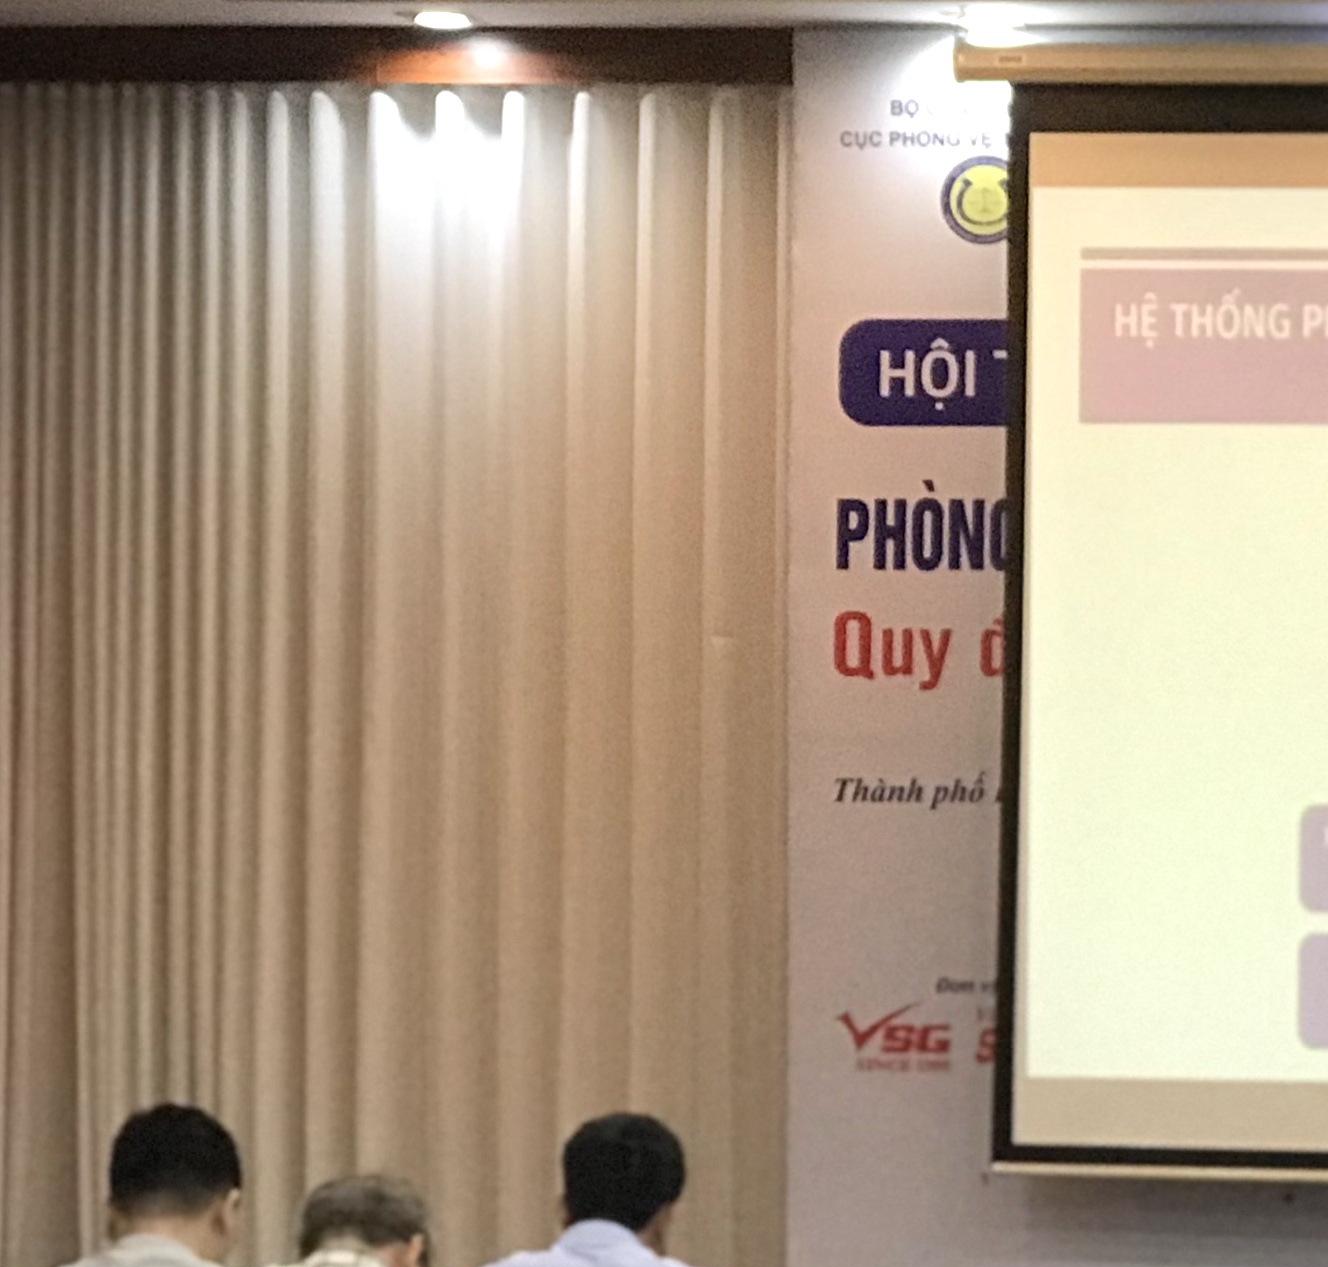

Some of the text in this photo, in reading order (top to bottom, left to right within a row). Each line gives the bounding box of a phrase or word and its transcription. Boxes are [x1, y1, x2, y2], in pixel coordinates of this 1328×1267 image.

[1115, 292, 1158, 349] HỆ
[1170, 288, 1291, 340] THỐNG
[878, 337, 976, 411] HỘI
[833, 610, 953, 690] Quy
[834, 777, 924, 802] Thành
[929, 771, 985, 810] phố
